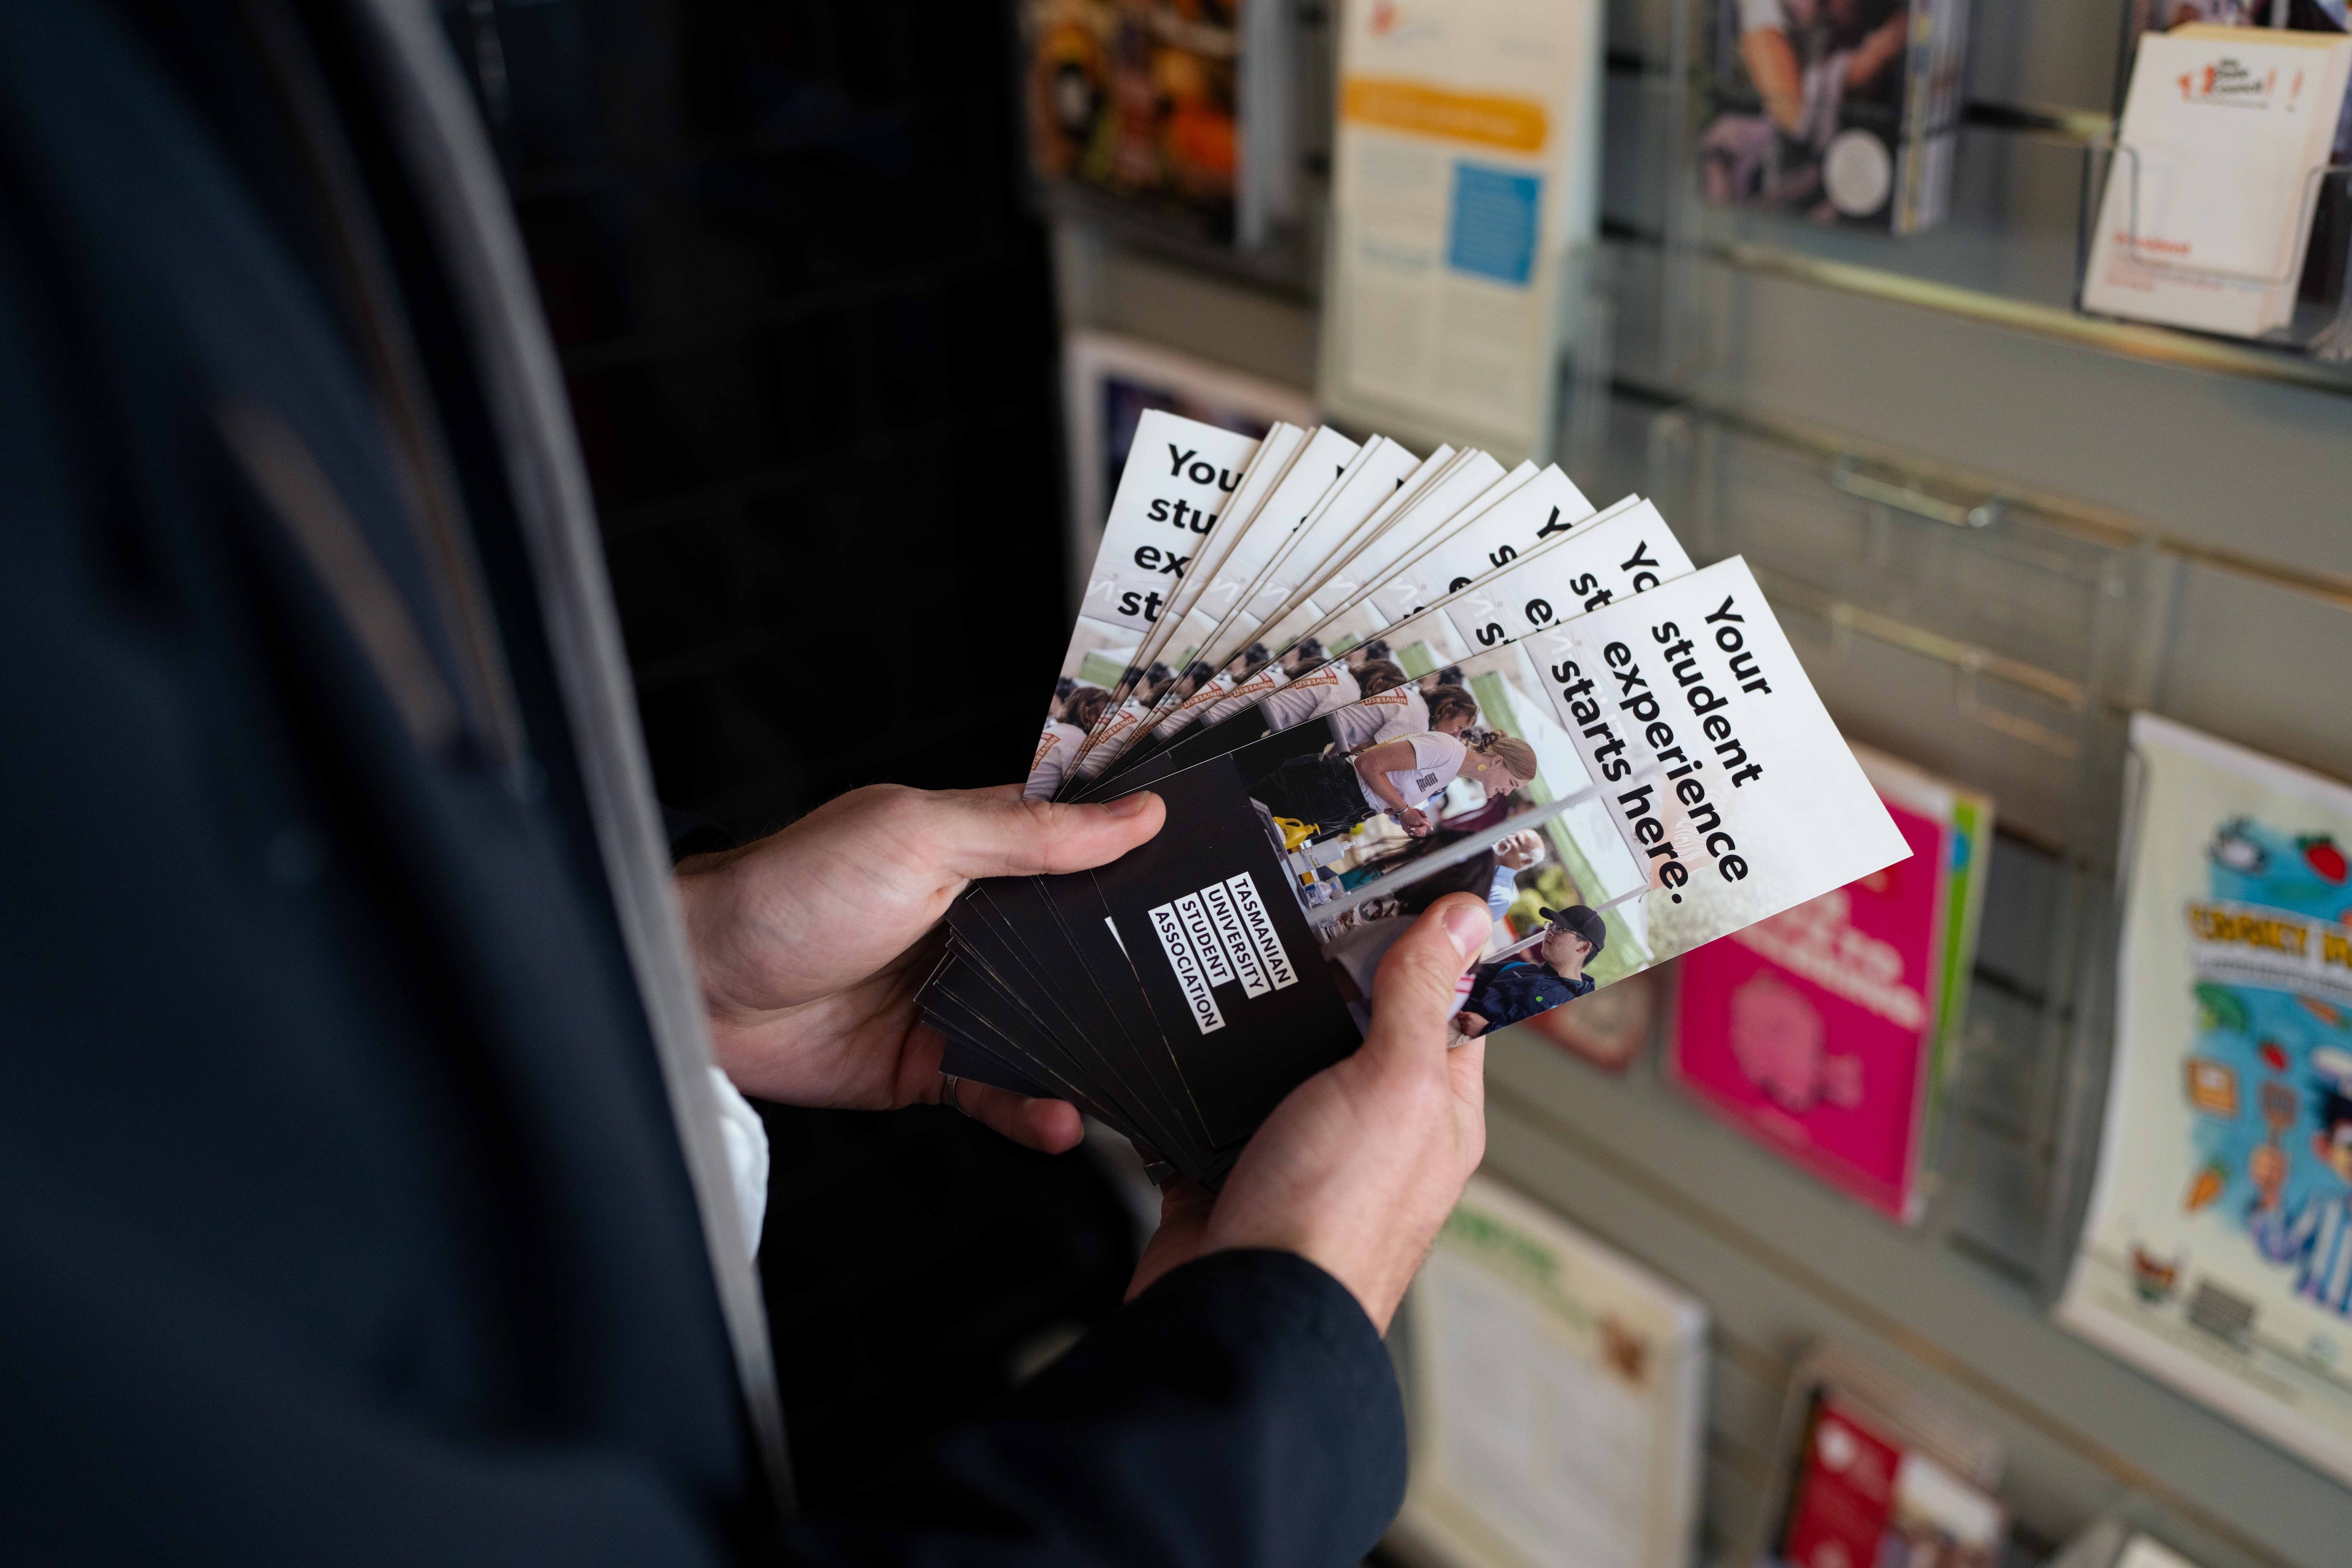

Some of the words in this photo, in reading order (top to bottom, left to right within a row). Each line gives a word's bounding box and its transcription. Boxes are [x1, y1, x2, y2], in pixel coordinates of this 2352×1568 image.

[1147, 499, 1218, 537] stu
[1168, 443, 1244, 494] You
[1134, 545, 1192, 580] ex
[1704, 595, 1772, 695] Your
[1652, 622, 1764, 788] student
[1551, 661, 1632, 782] starts
[1617, 784, 1689, 904] here.
[1604, 642, 1748, 883] experience
[1155, 912, 1218, 1027] ASSOCIATION
[1182, 900, 1228, 978] STUDENT
[1208, 889, 1264, 988] UNIVERSITY
[1234, 878, 1291, 984] TASMANIAN
